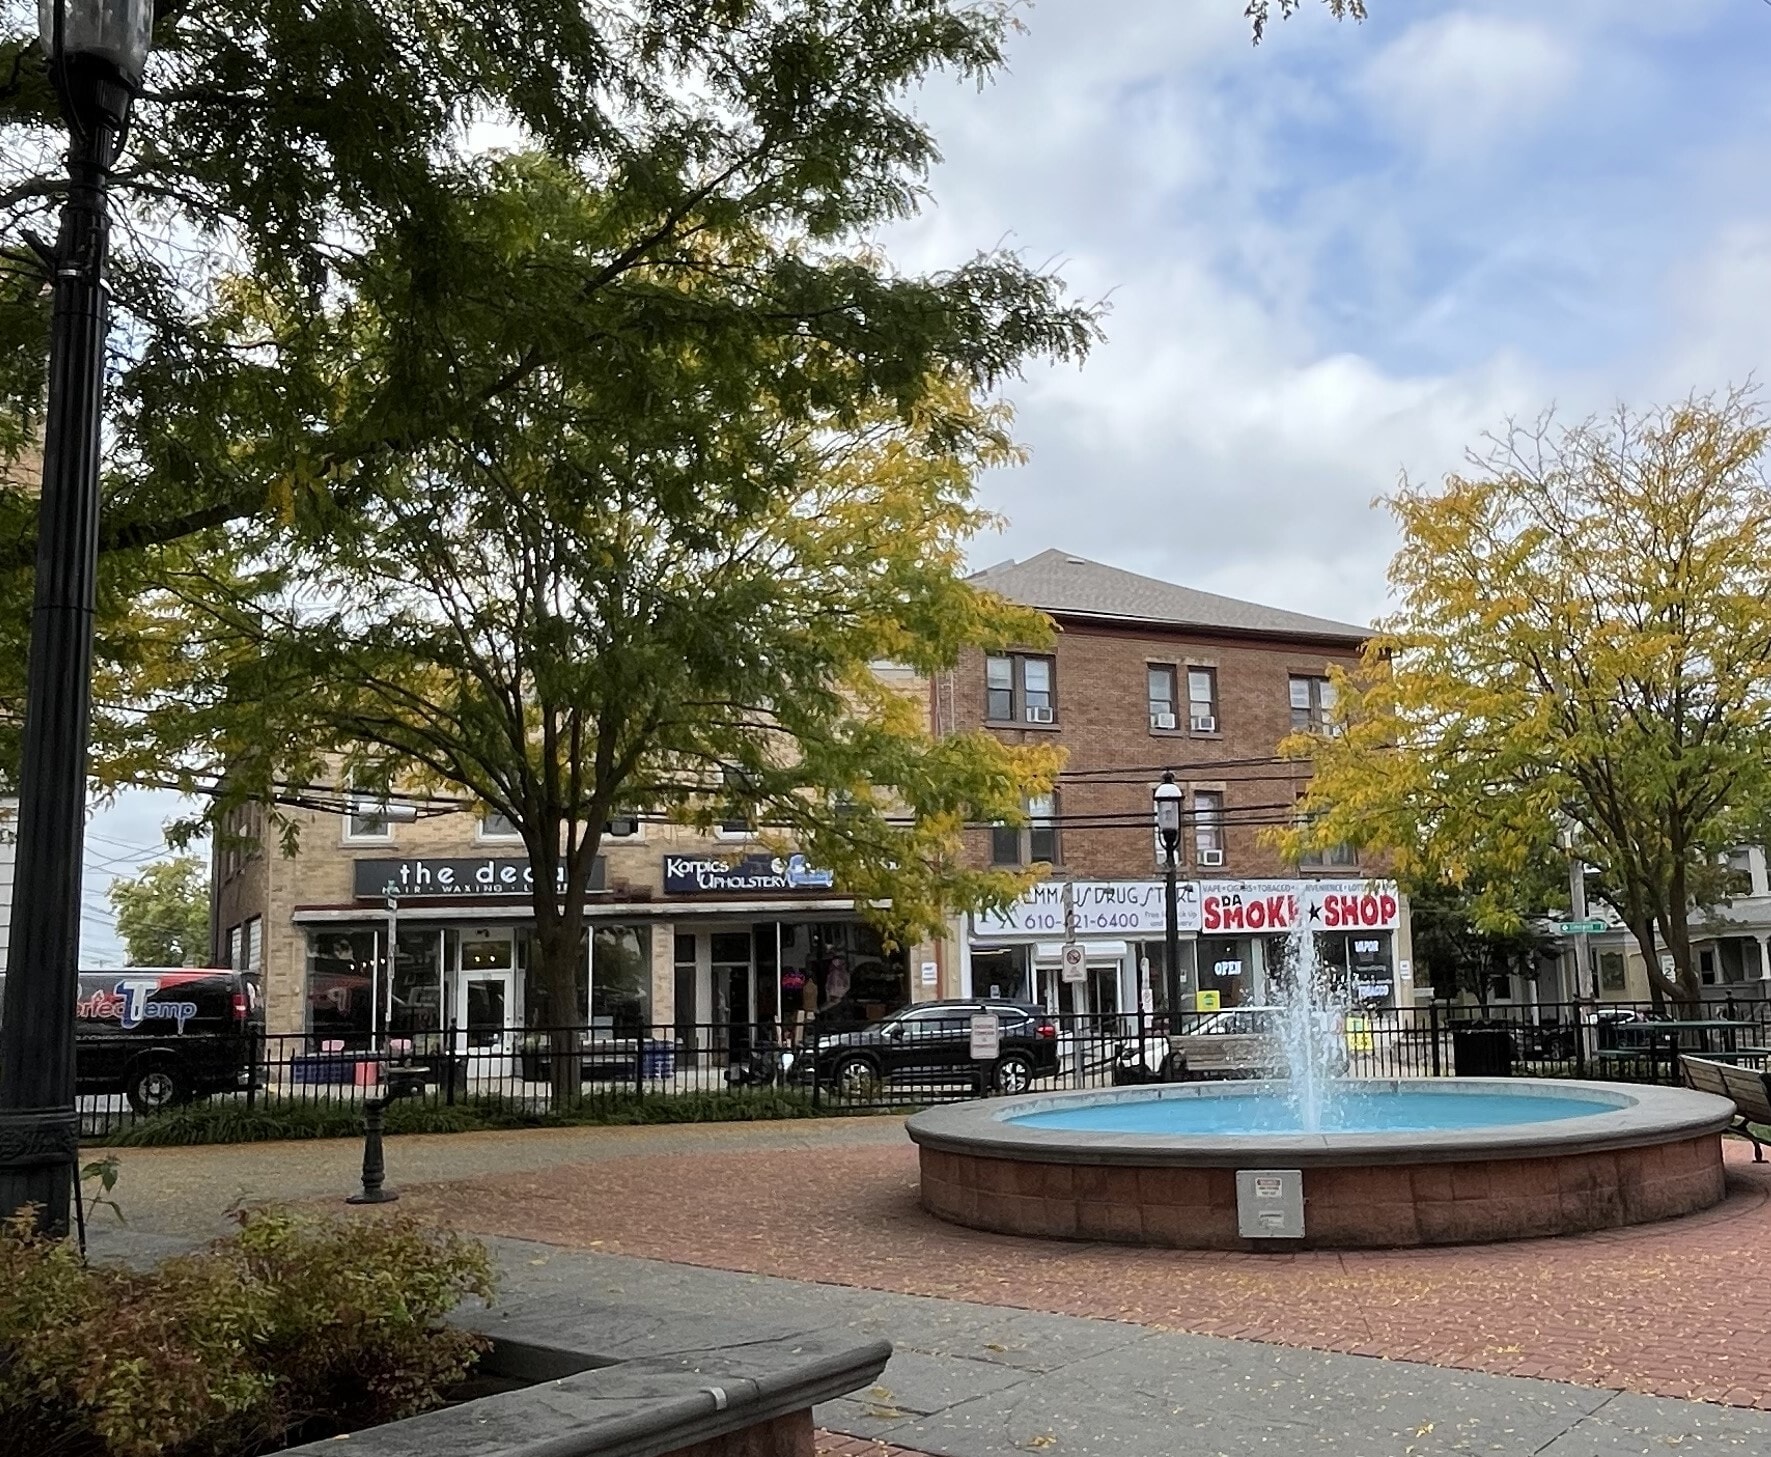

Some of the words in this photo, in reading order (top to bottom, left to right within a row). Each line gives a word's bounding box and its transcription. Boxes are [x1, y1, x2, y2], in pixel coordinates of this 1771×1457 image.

[399, 861, 454, 885] the
[667, 858, 729, 882] Korpics
[442, 884, 503, 893] WAXING
[1095, 887, 1136, 904] DRUG
[1222, 895, 1242, 907] DA
[1324, 894, 1396, 926] SHOP
[1025, 913, 1139, 931] 610-21-6400
[1214, 960, 1242, 976] OPEN
